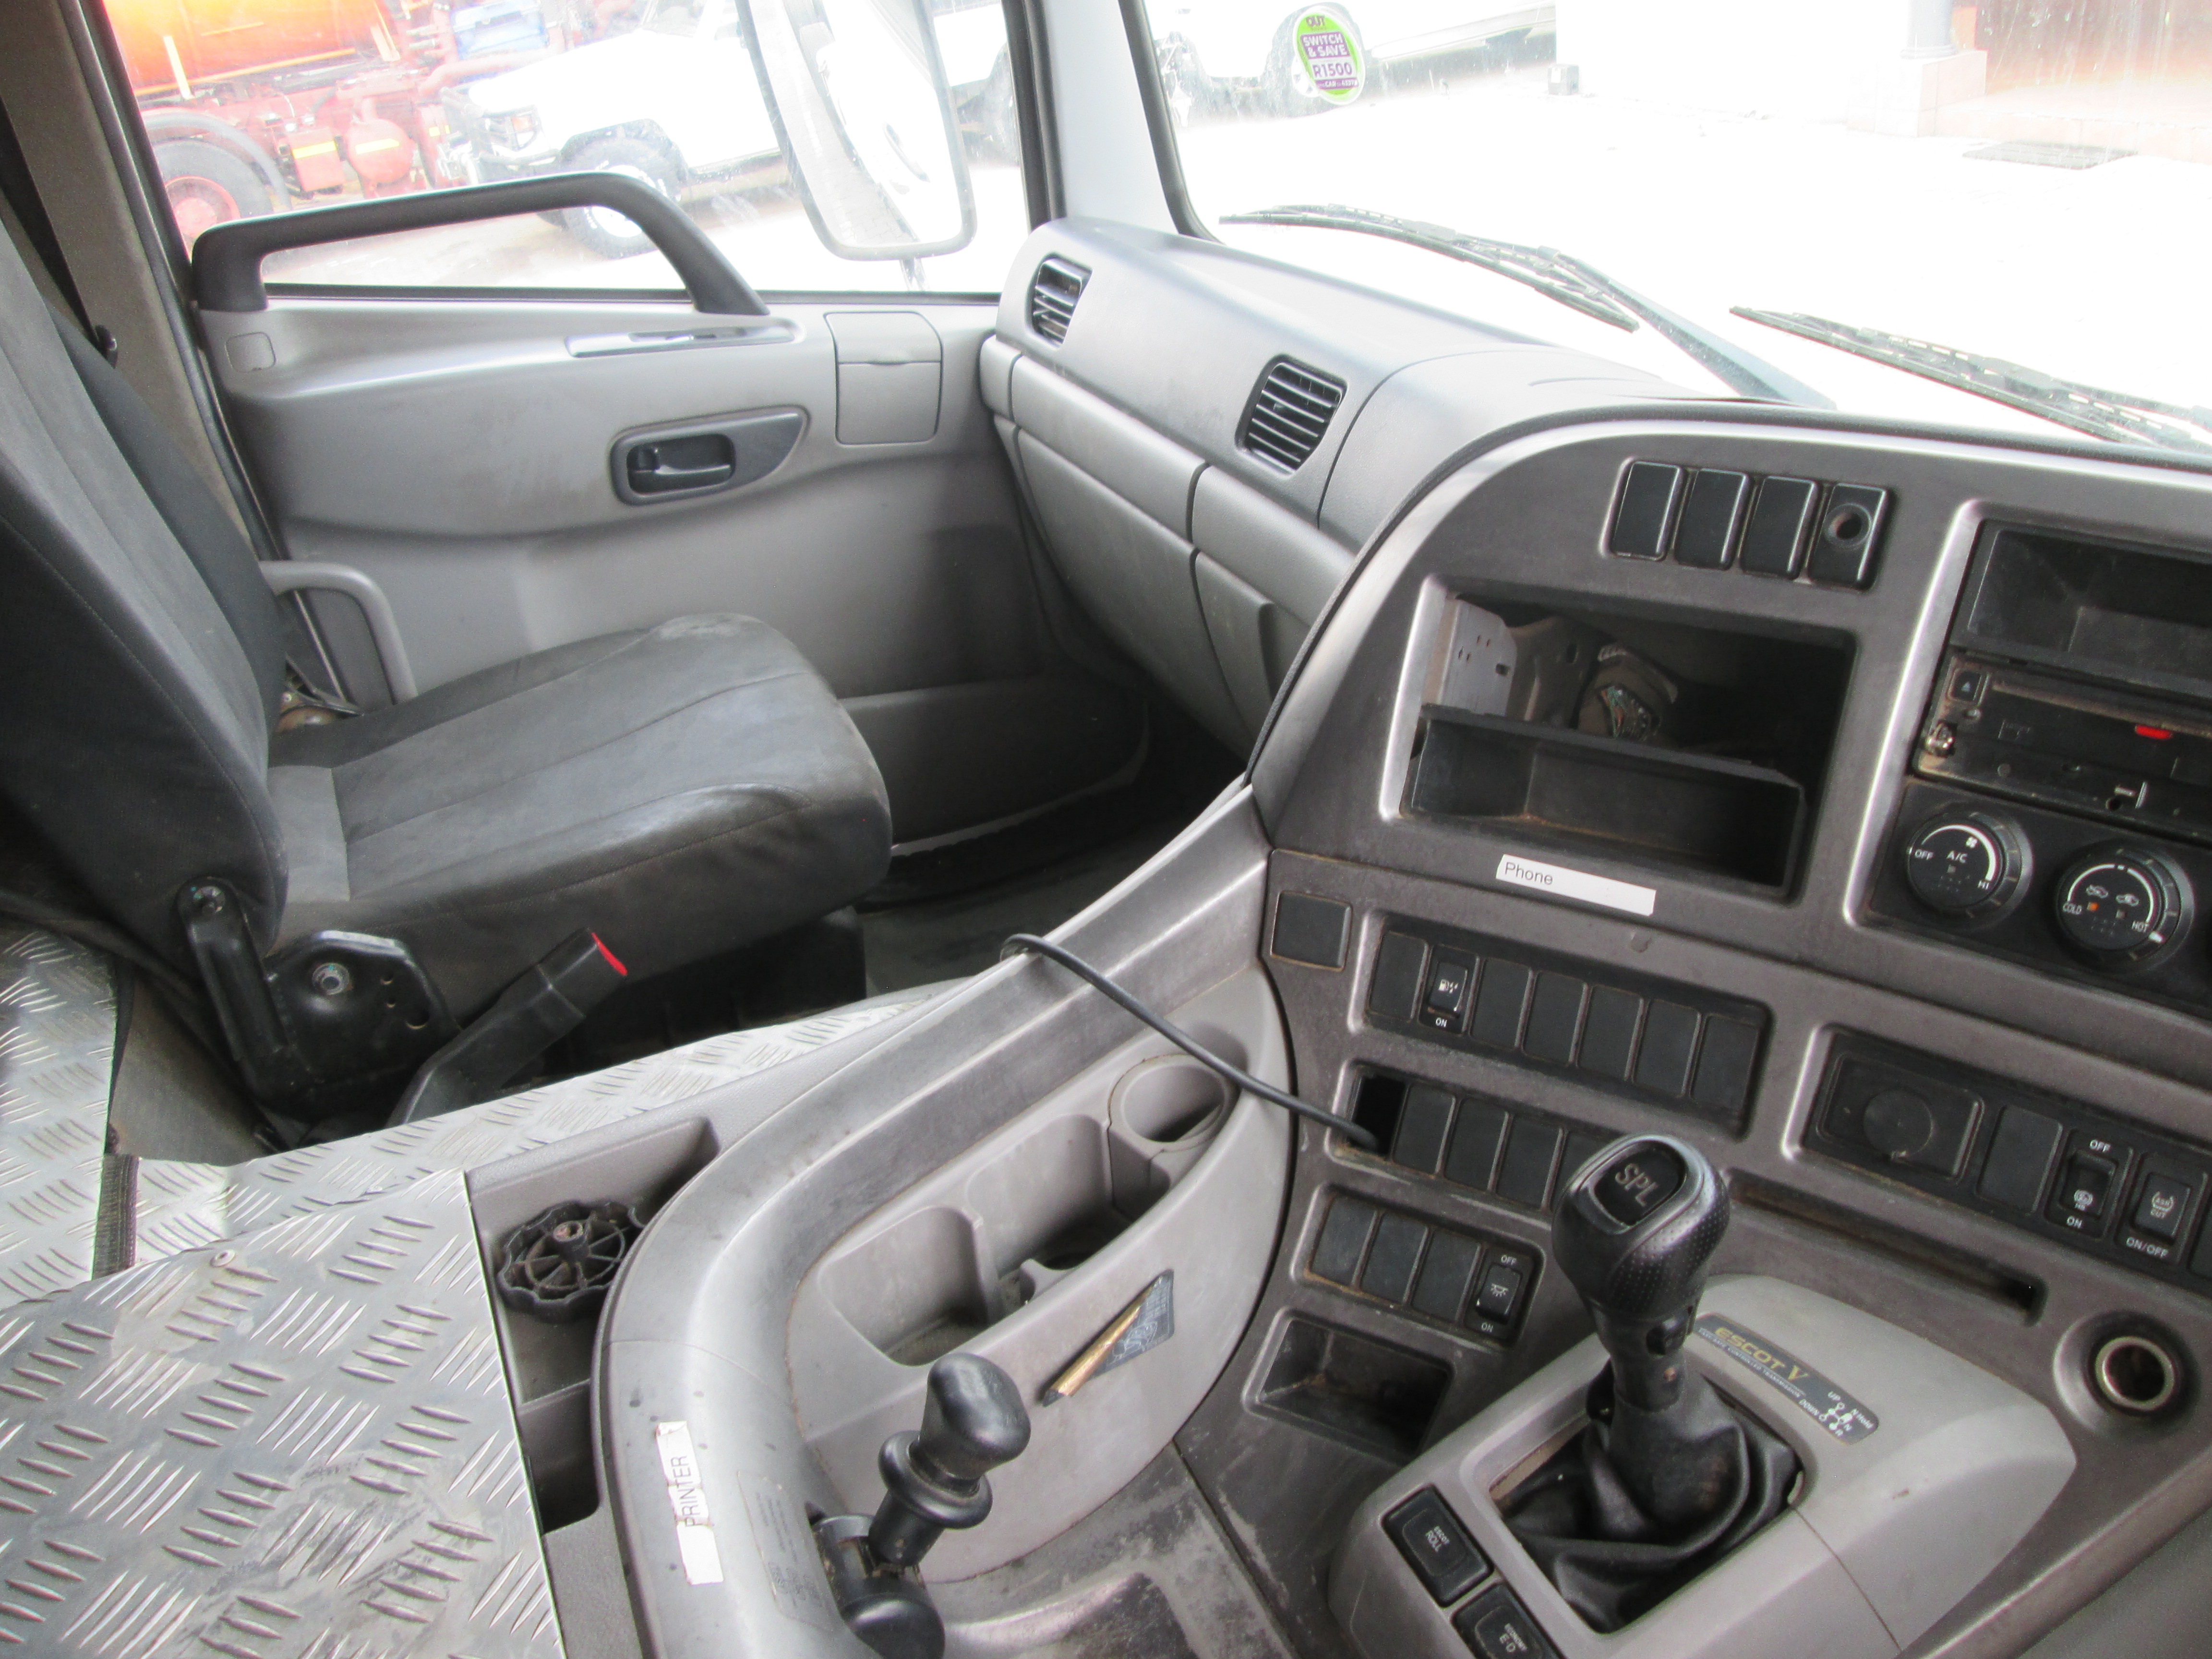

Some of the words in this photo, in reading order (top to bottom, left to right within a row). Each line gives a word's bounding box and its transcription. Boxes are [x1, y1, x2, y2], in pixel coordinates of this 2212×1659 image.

[1306, 15, 1325, 27] OUT
[1303, 33, 1344, 47] SWITCH
[1308, 47, 1317, 58] &
[1317, 44, 1347, 57] SAVE
[1312, 62, 1353, 78] R1500
[1914, 848, 1934, 860] OFF
[1947, 850, 1968, 864] A/C
[1504, 862, 1553, 885] Phone
[1977, 880, 1990, 890] HI
[2063, 902, 2082, 915] COLD
[2131, 920, 2149, 933] HOT
[1435, 1017, 1447, 1028] ON
[2090, 1139, 2111, 1153] OFF
[2067, 1215, 2083, 1229] ON
[2126, 1237, 2169, 1258] ON/OFF
[1501, 1254, 1517, 1266] OFF
[1481, 1322, 1493, 1333] ON
[1715, 1327, 1786, 1369] ESCOT
[1788, 1365, 1809, 1380] V
[1828, 1391, 1841, 1401] UP
[1799, 1399, 1820, 1416] DOWN
[671, 1455, 701, 1527] PRINTER
[1424, 1530, 1442, 1552] ROLL
